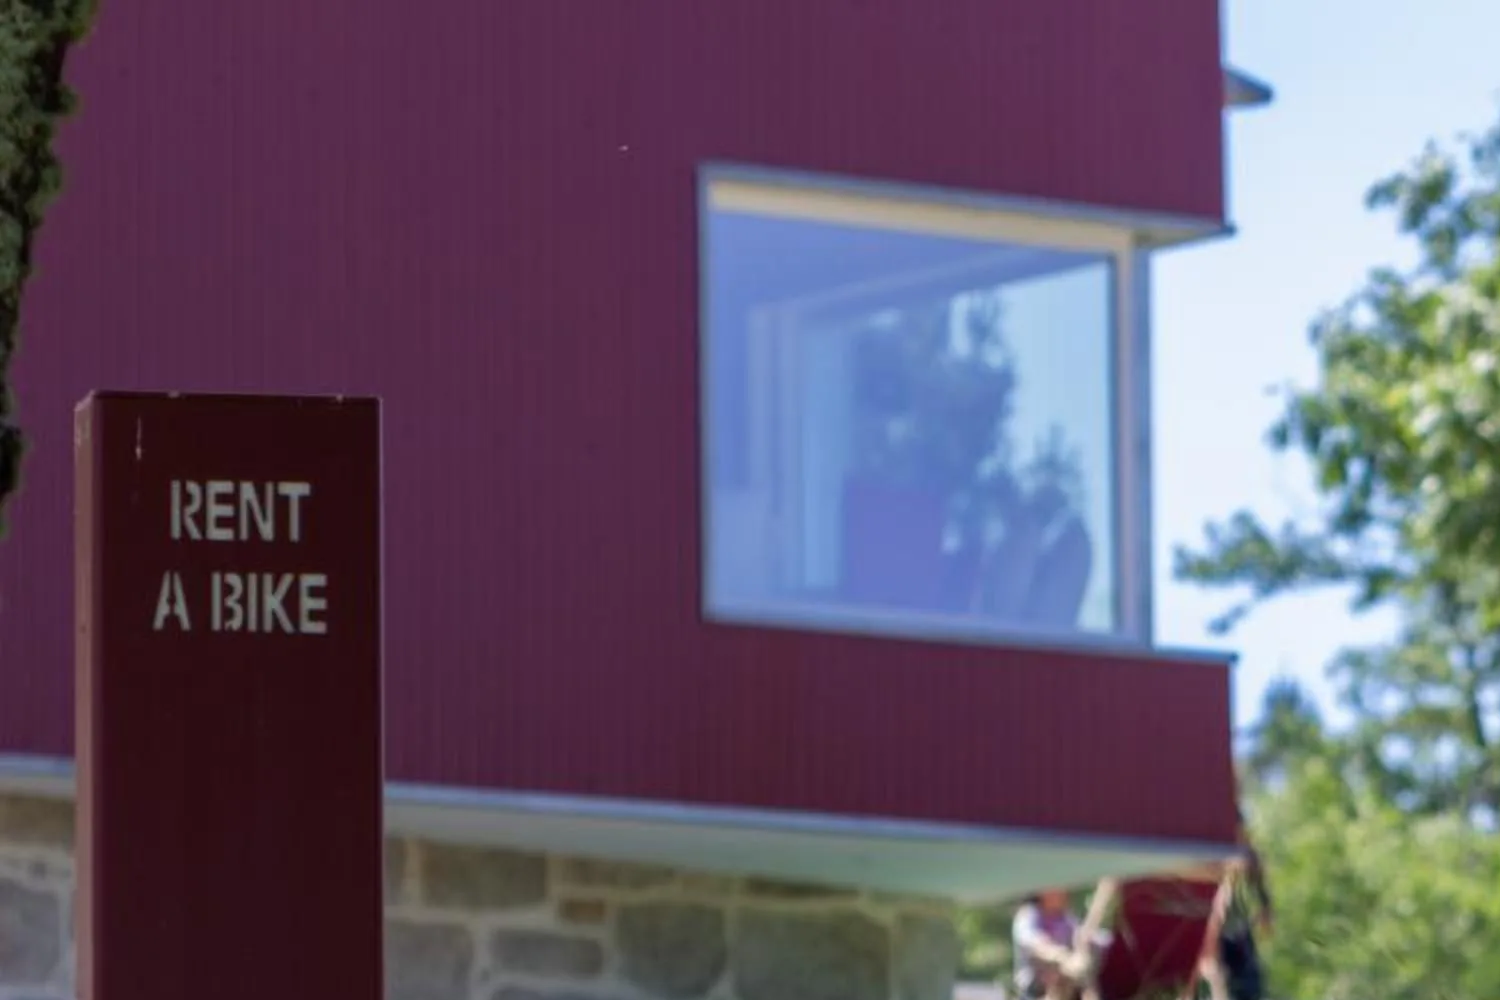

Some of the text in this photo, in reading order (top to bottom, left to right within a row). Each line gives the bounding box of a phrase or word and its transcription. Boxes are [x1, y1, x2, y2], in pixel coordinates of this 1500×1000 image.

[171, 480, 310, 541] RENT
[153, 571, 327, 633] A BIKE
